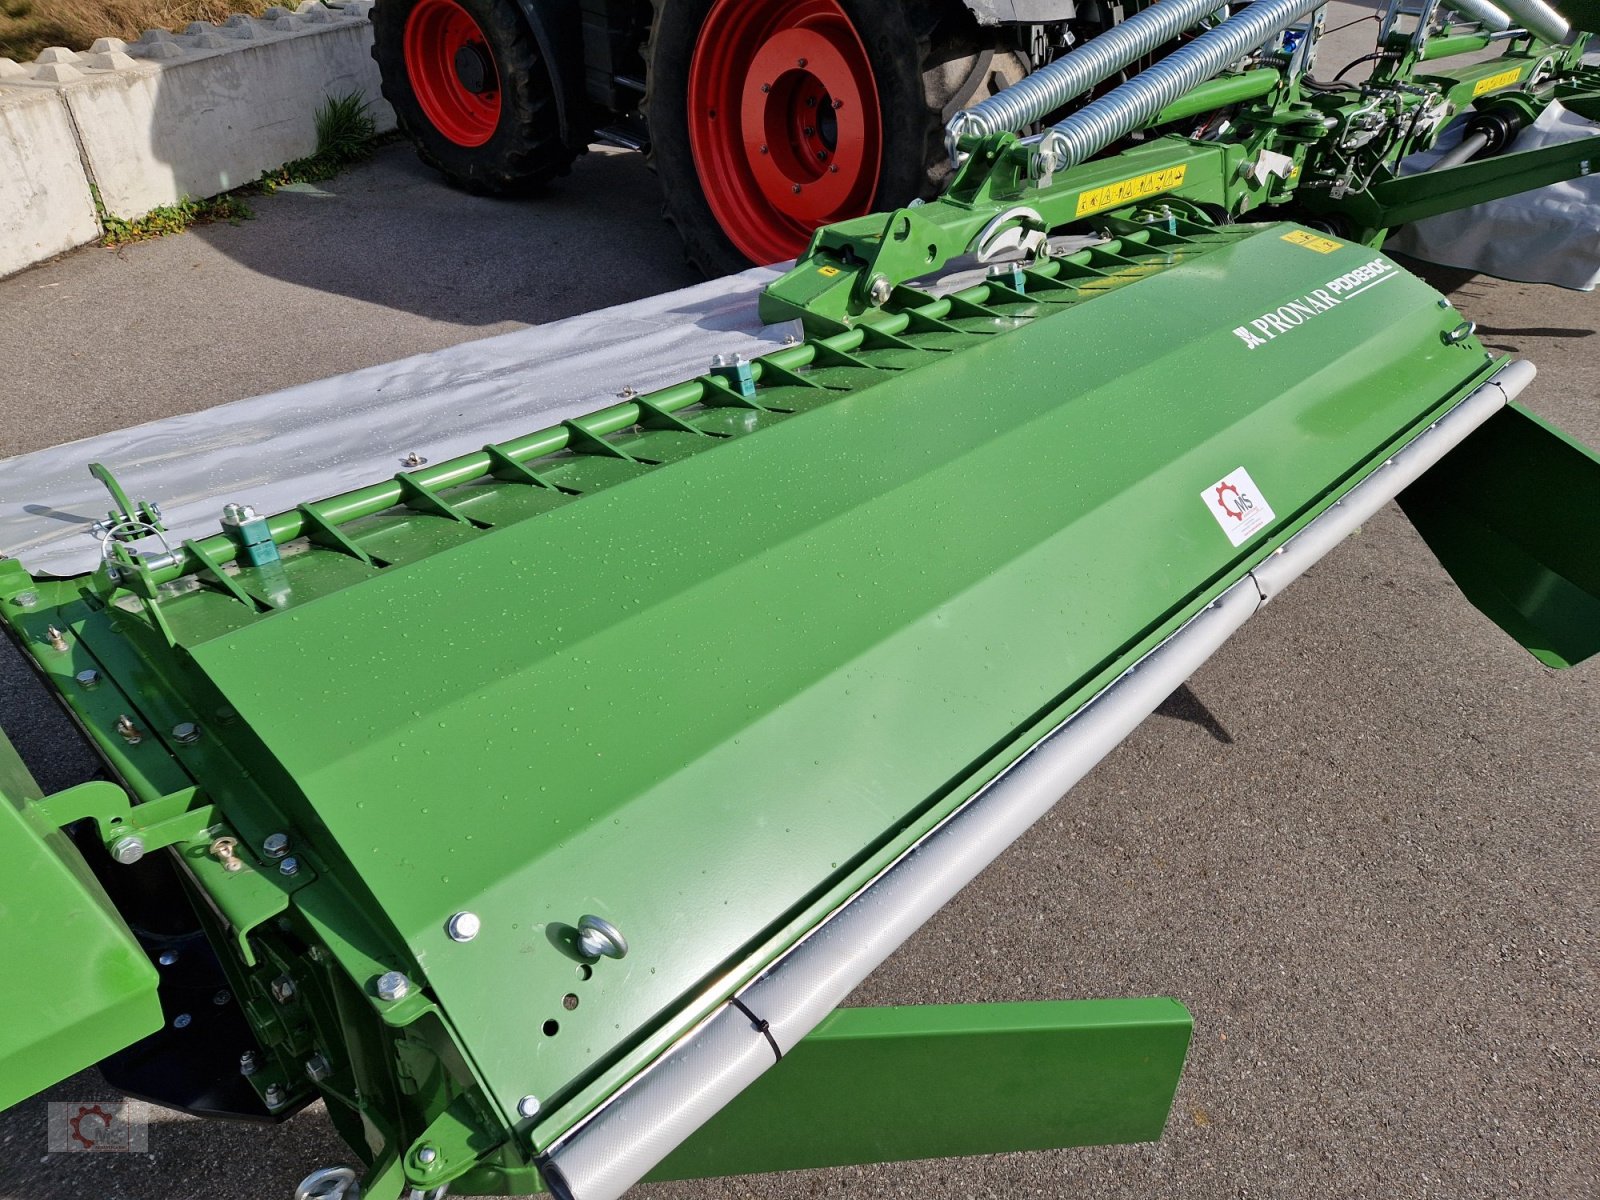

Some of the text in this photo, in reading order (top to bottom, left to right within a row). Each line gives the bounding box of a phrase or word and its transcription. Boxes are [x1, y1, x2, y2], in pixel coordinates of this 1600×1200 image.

[1250, 258, 1392, 339] PRONAR PDD830C
[1234, 493, 1253, 513] MS
